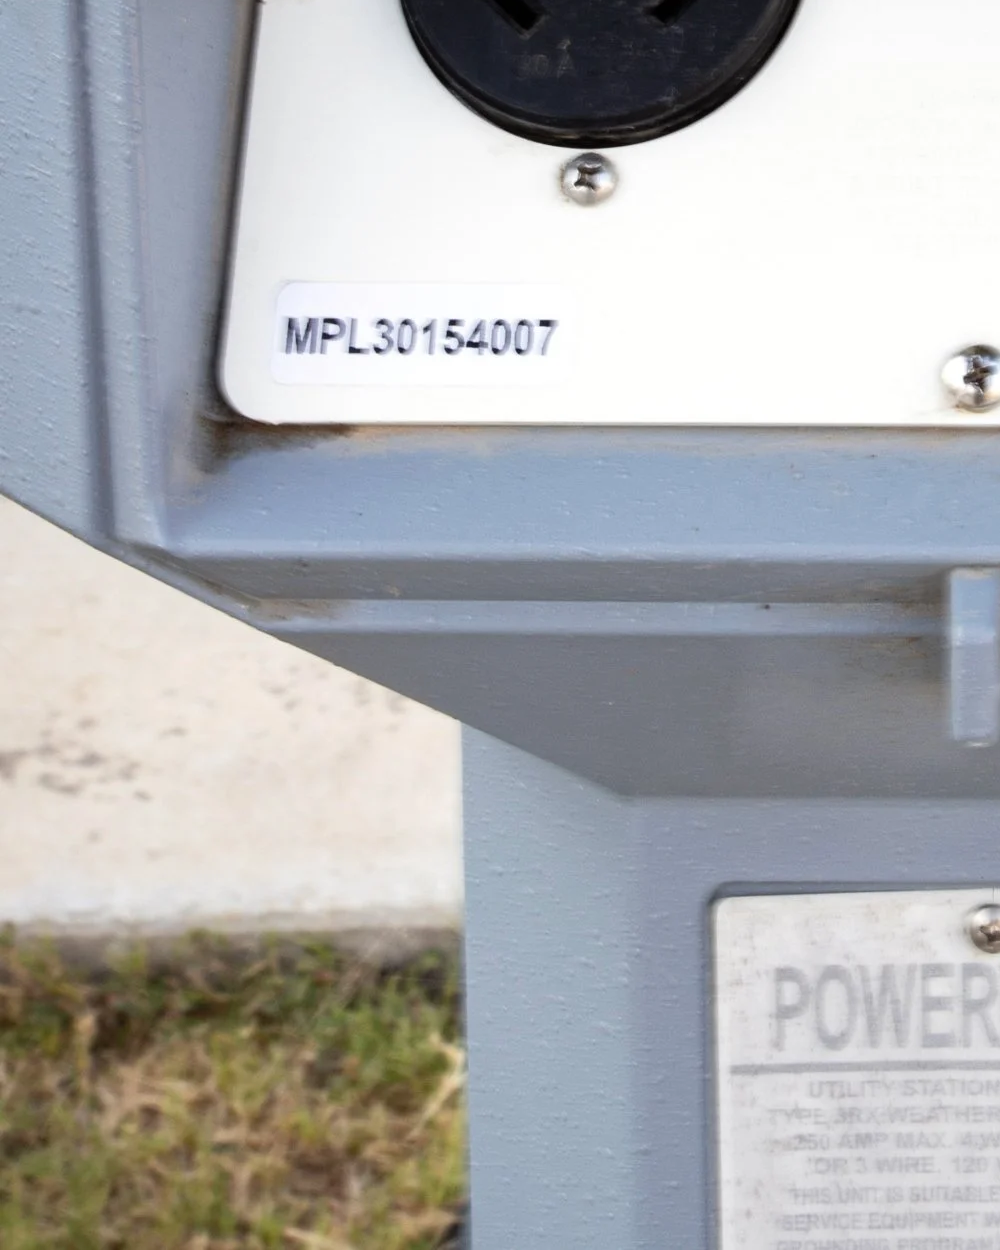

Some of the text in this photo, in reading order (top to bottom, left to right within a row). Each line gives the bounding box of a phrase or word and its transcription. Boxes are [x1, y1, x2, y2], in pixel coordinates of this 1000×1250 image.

[284, 317, 559, 356] MPL30154007
[808, 1079, 896, 1098] UTILITY
[902, 1078, 1000, 1098] STATION
[767, 1107, 827, 1125] TYPE
[838, 1132, 890, 1150] AMP
[952, 1155, 988, 1174] 120
[789, 1186, 832, 1204] THIS
[837, 1186, 879, 1204] UNIT
[886, 1186, 904, 1203] IS
[780, 1213, 863, 1232] SERVICE
